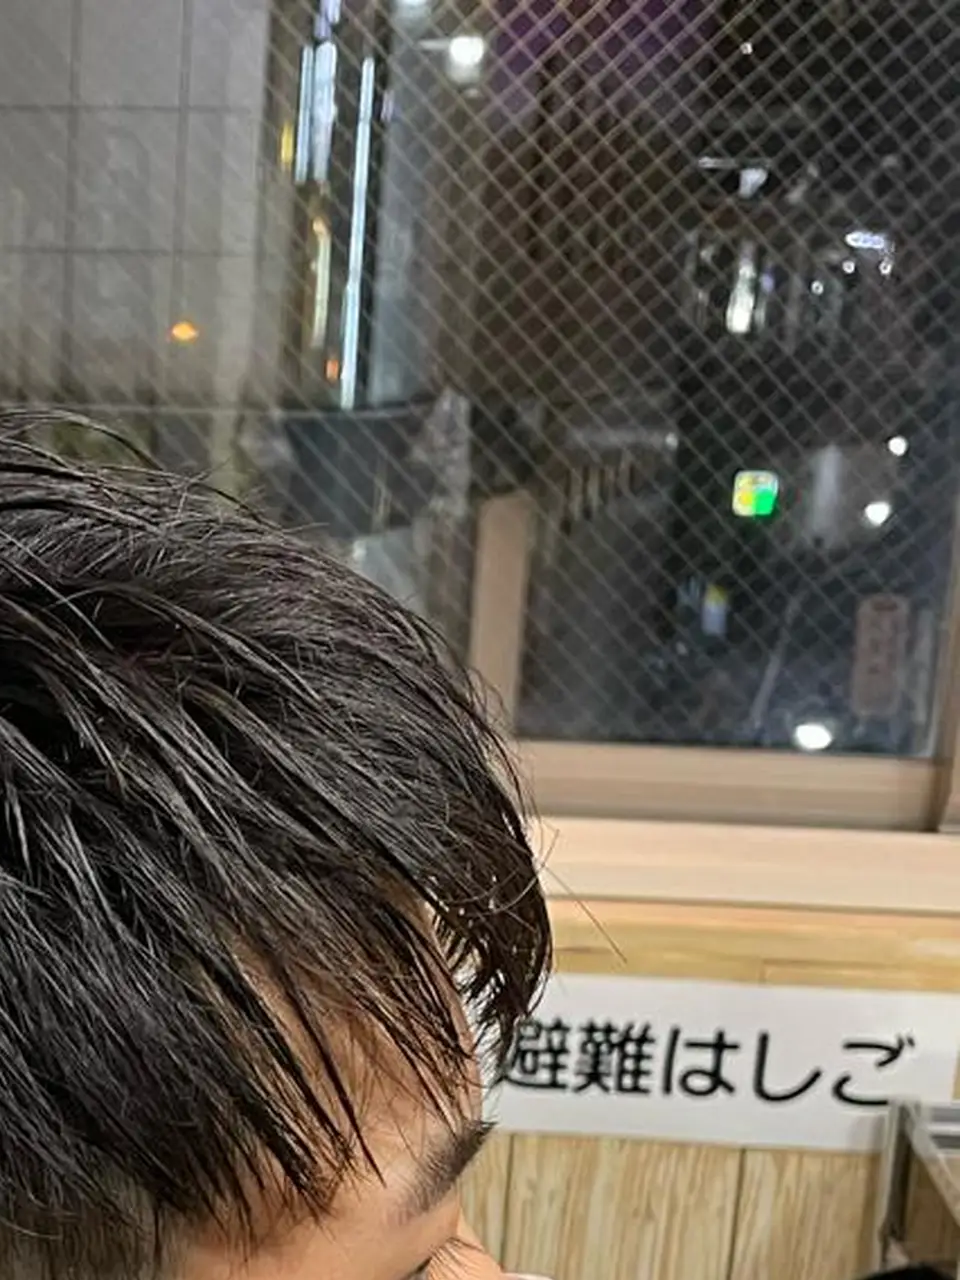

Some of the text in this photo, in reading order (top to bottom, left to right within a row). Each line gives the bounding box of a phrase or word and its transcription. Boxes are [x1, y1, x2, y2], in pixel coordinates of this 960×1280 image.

[503, 1018, 915, 1106] 避難はしご
